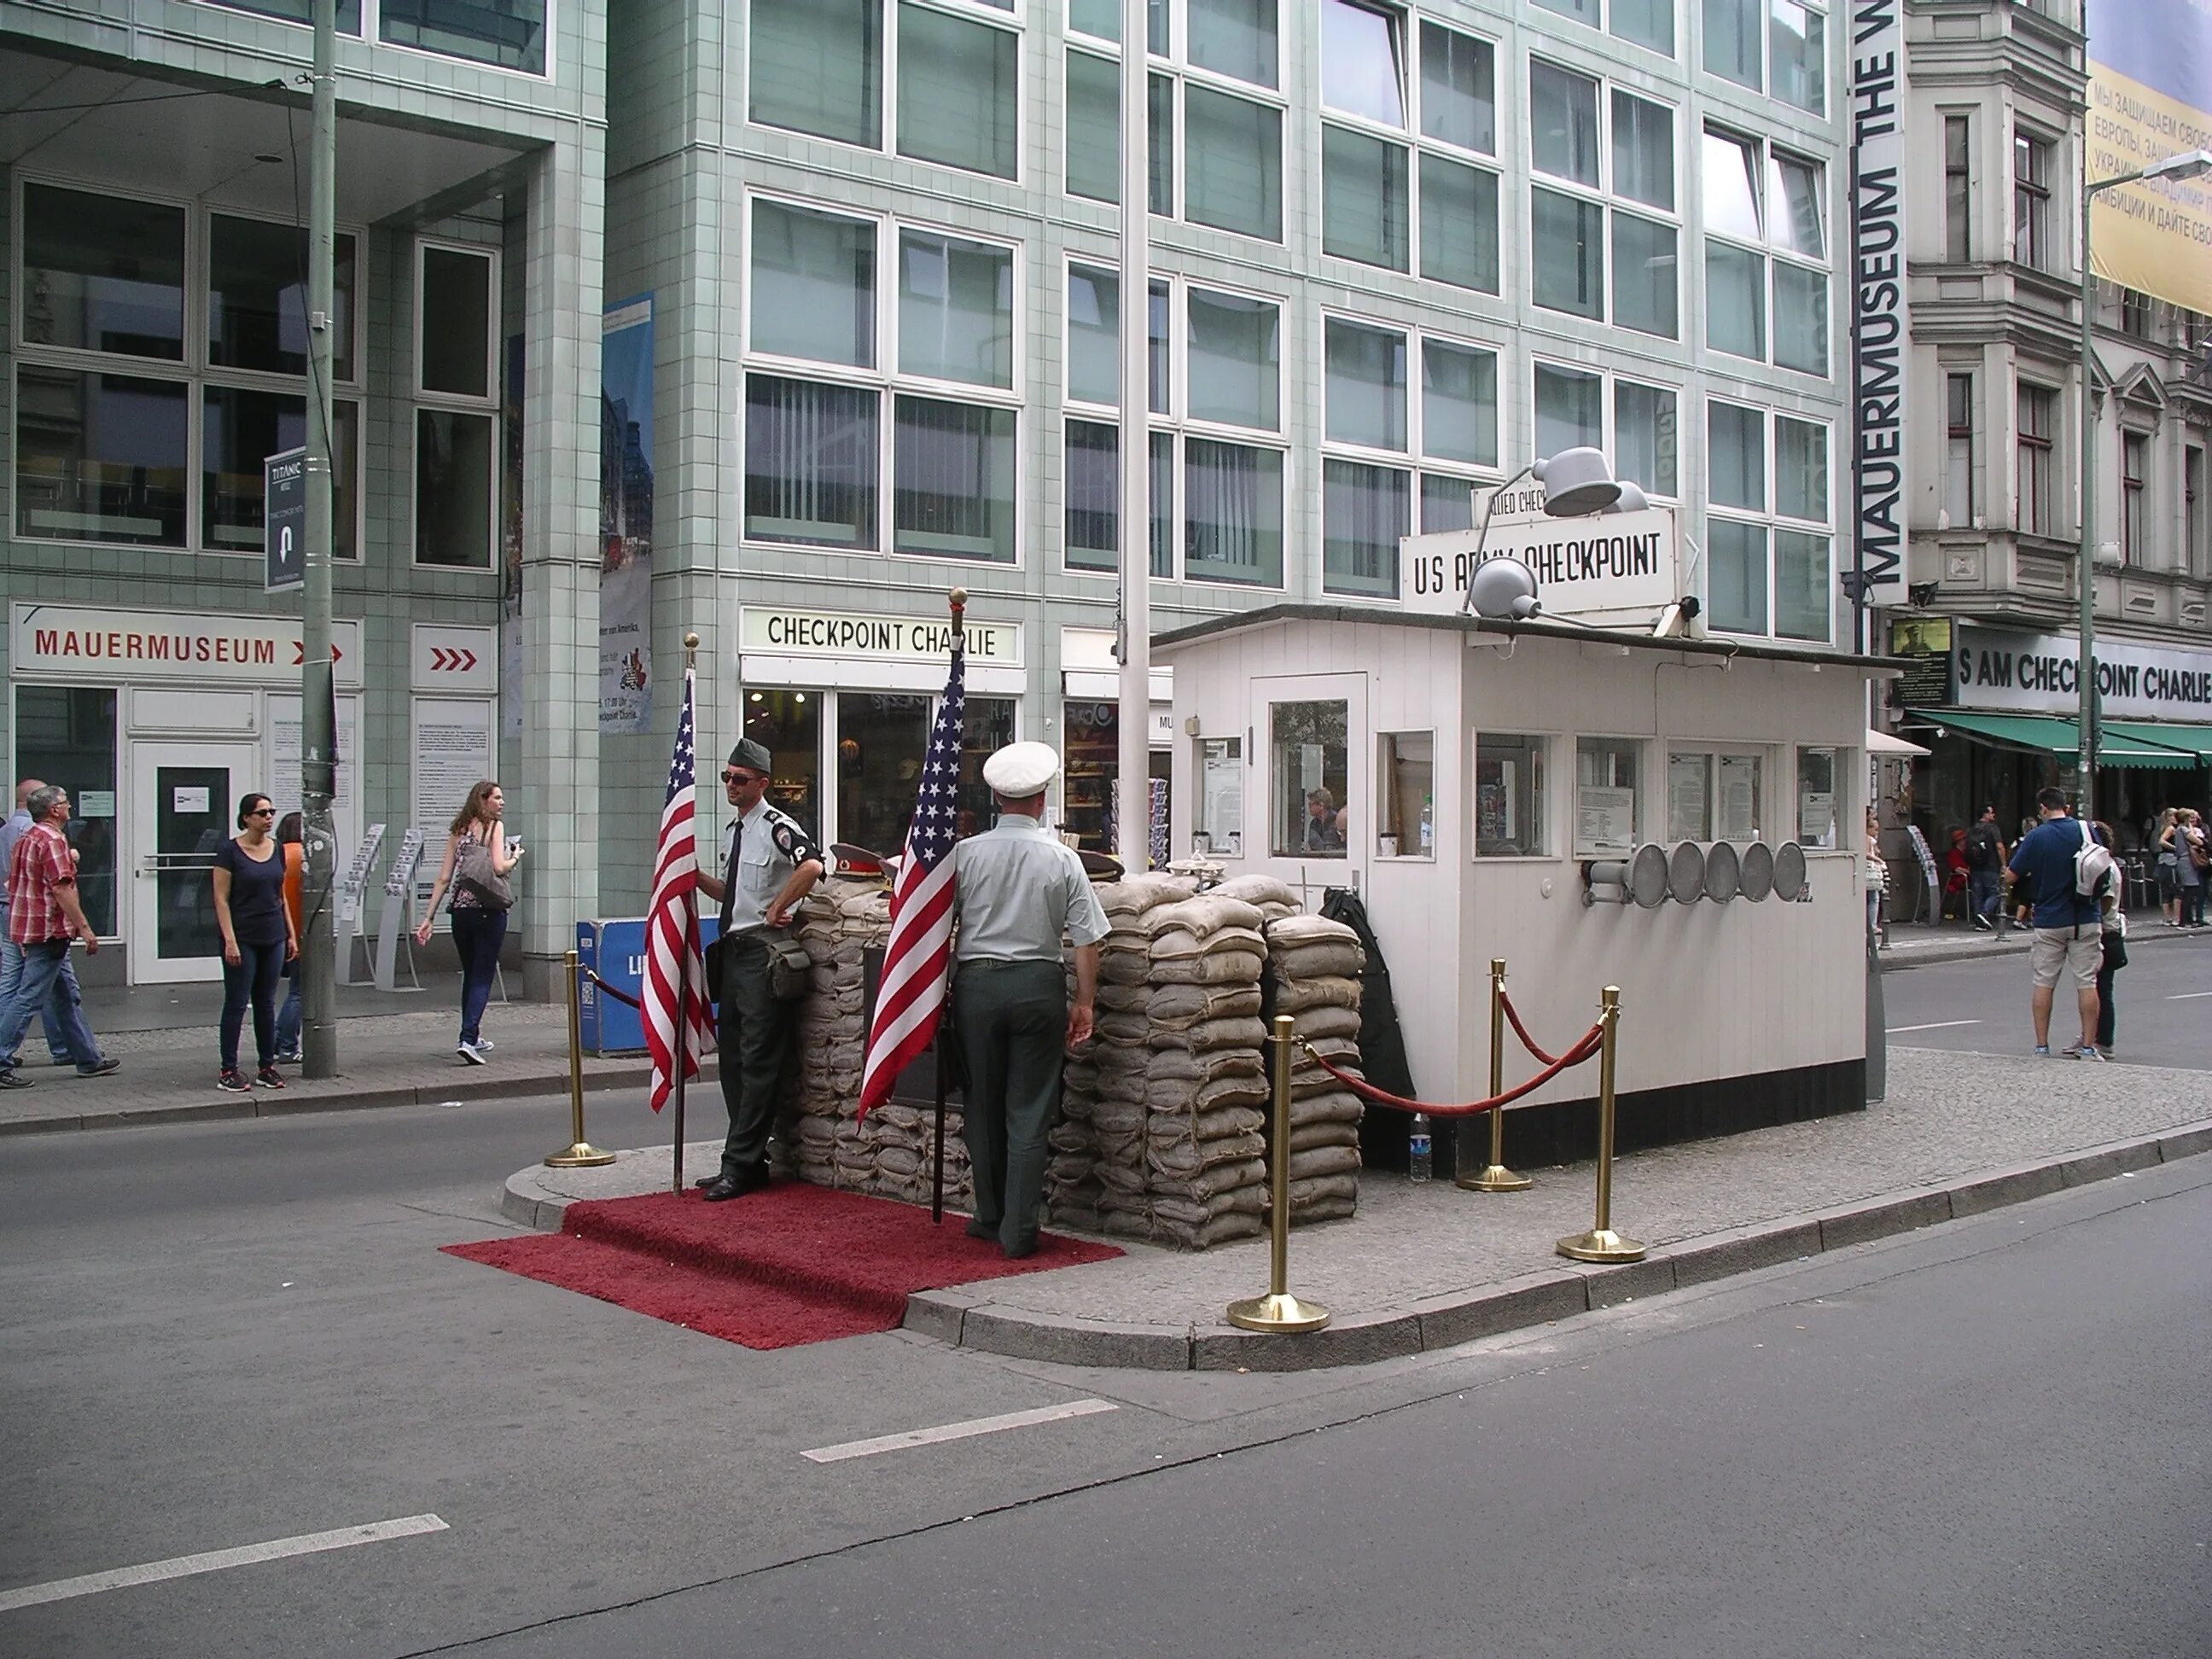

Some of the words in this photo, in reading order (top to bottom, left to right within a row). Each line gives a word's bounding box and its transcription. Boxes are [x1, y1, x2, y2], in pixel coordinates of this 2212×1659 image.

[1854, 50, 1895, 147] THE
[2094, 83, 2113, 108] МЫ
[2115, 92, 2177, 139] ЗАЩИЩАЕМ
[2095, 115, 2143, 158] ЕВРОПЫ,
[2147, 203, 2156, 225] И
[2157, 207, 2191, 238] ДАЙТЕ
[1860, 166, 1902, 584] MAUERMUSEUM
[1489, 492, 1516, 515] LLIED
[1414, 556, 1443, 595] US
[1524, 533, 1661, 585] CHECKPOINT
[35, 629, 275, 664] MAUERMUSEUM
[768, 616, 903, 650] CHECKPOINT
[1976, 650, 2012, 688] AM
[2018, 654, 2139, 698] CHECOINT
[2144, 667, 2212, 704] CHARLIE
